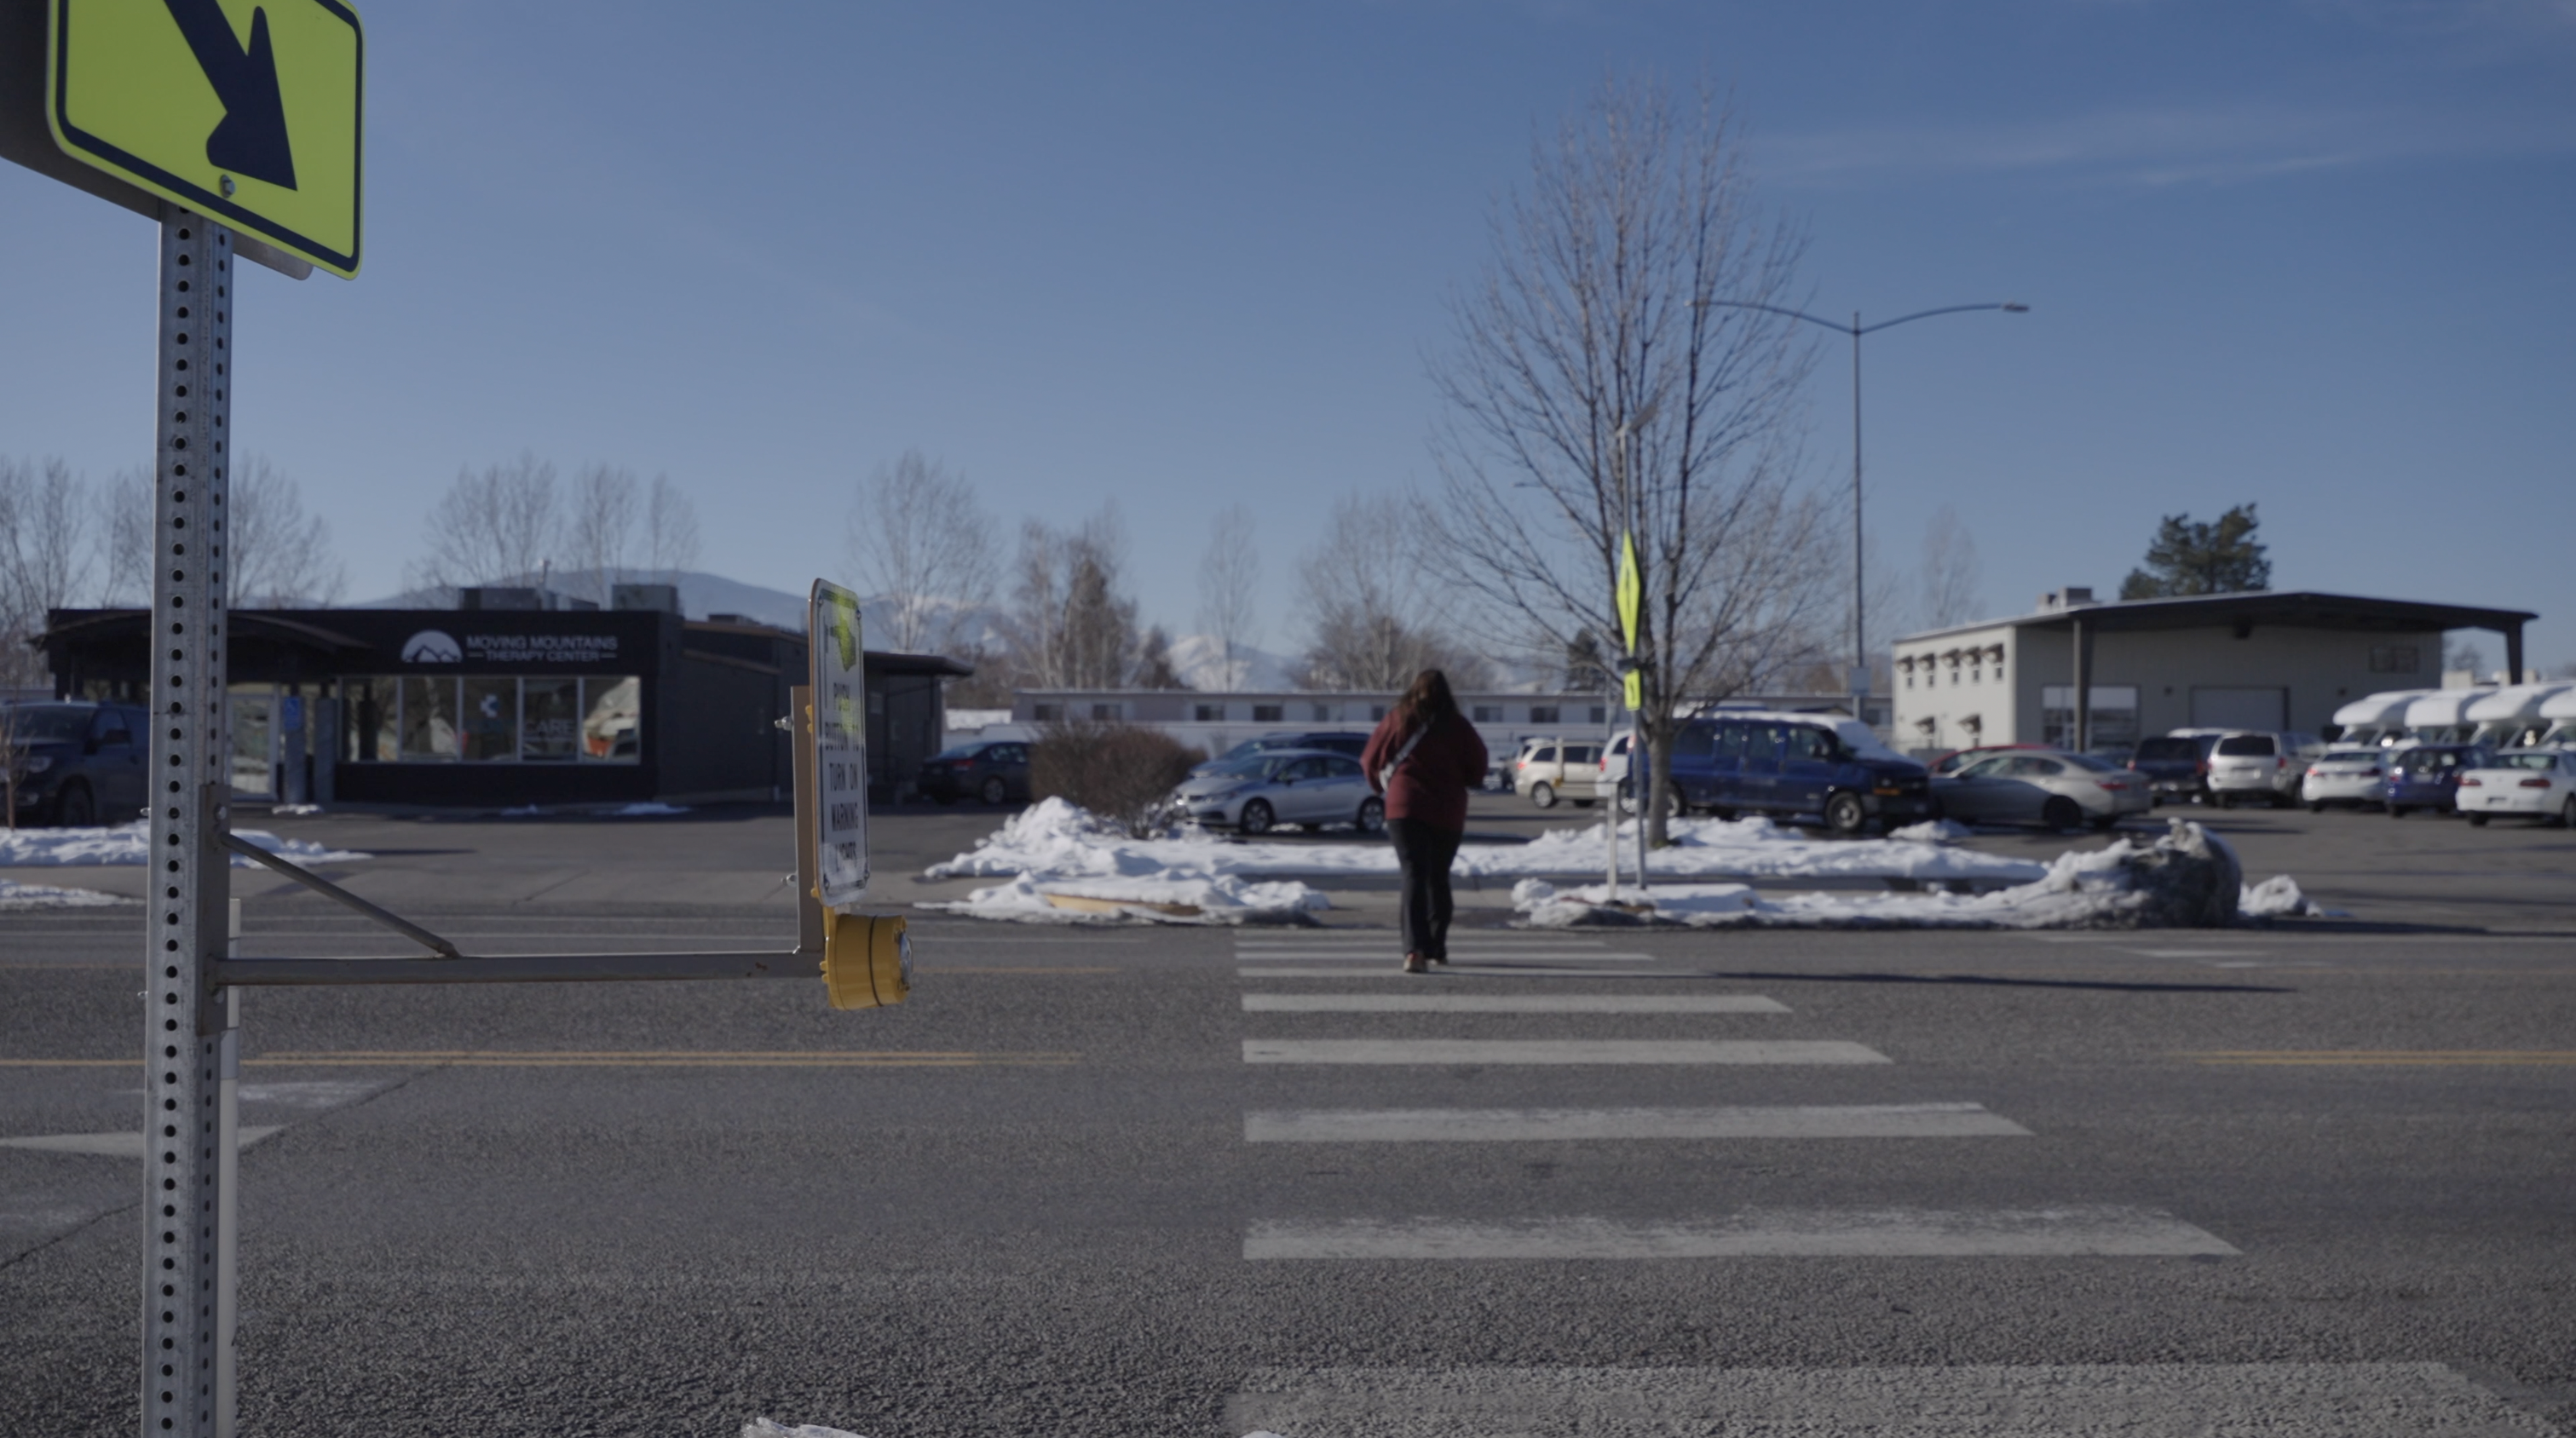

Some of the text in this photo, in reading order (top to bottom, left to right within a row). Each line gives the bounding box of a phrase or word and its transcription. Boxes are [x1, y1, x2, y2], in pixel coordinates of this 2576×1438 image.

[467, 635, 618, 650] MOVING MOUNTAINS
[487, 651, 600, 662] THERAPY CENTER
[833, 683, 850, 710] PUSH
[825, 722, 859, 751] BUTTON TO
[829, 762, 858, 791] TURN ON
[831, 802, 858, 831] WARNING
[835, 842, 857, 870] LIGHTS
